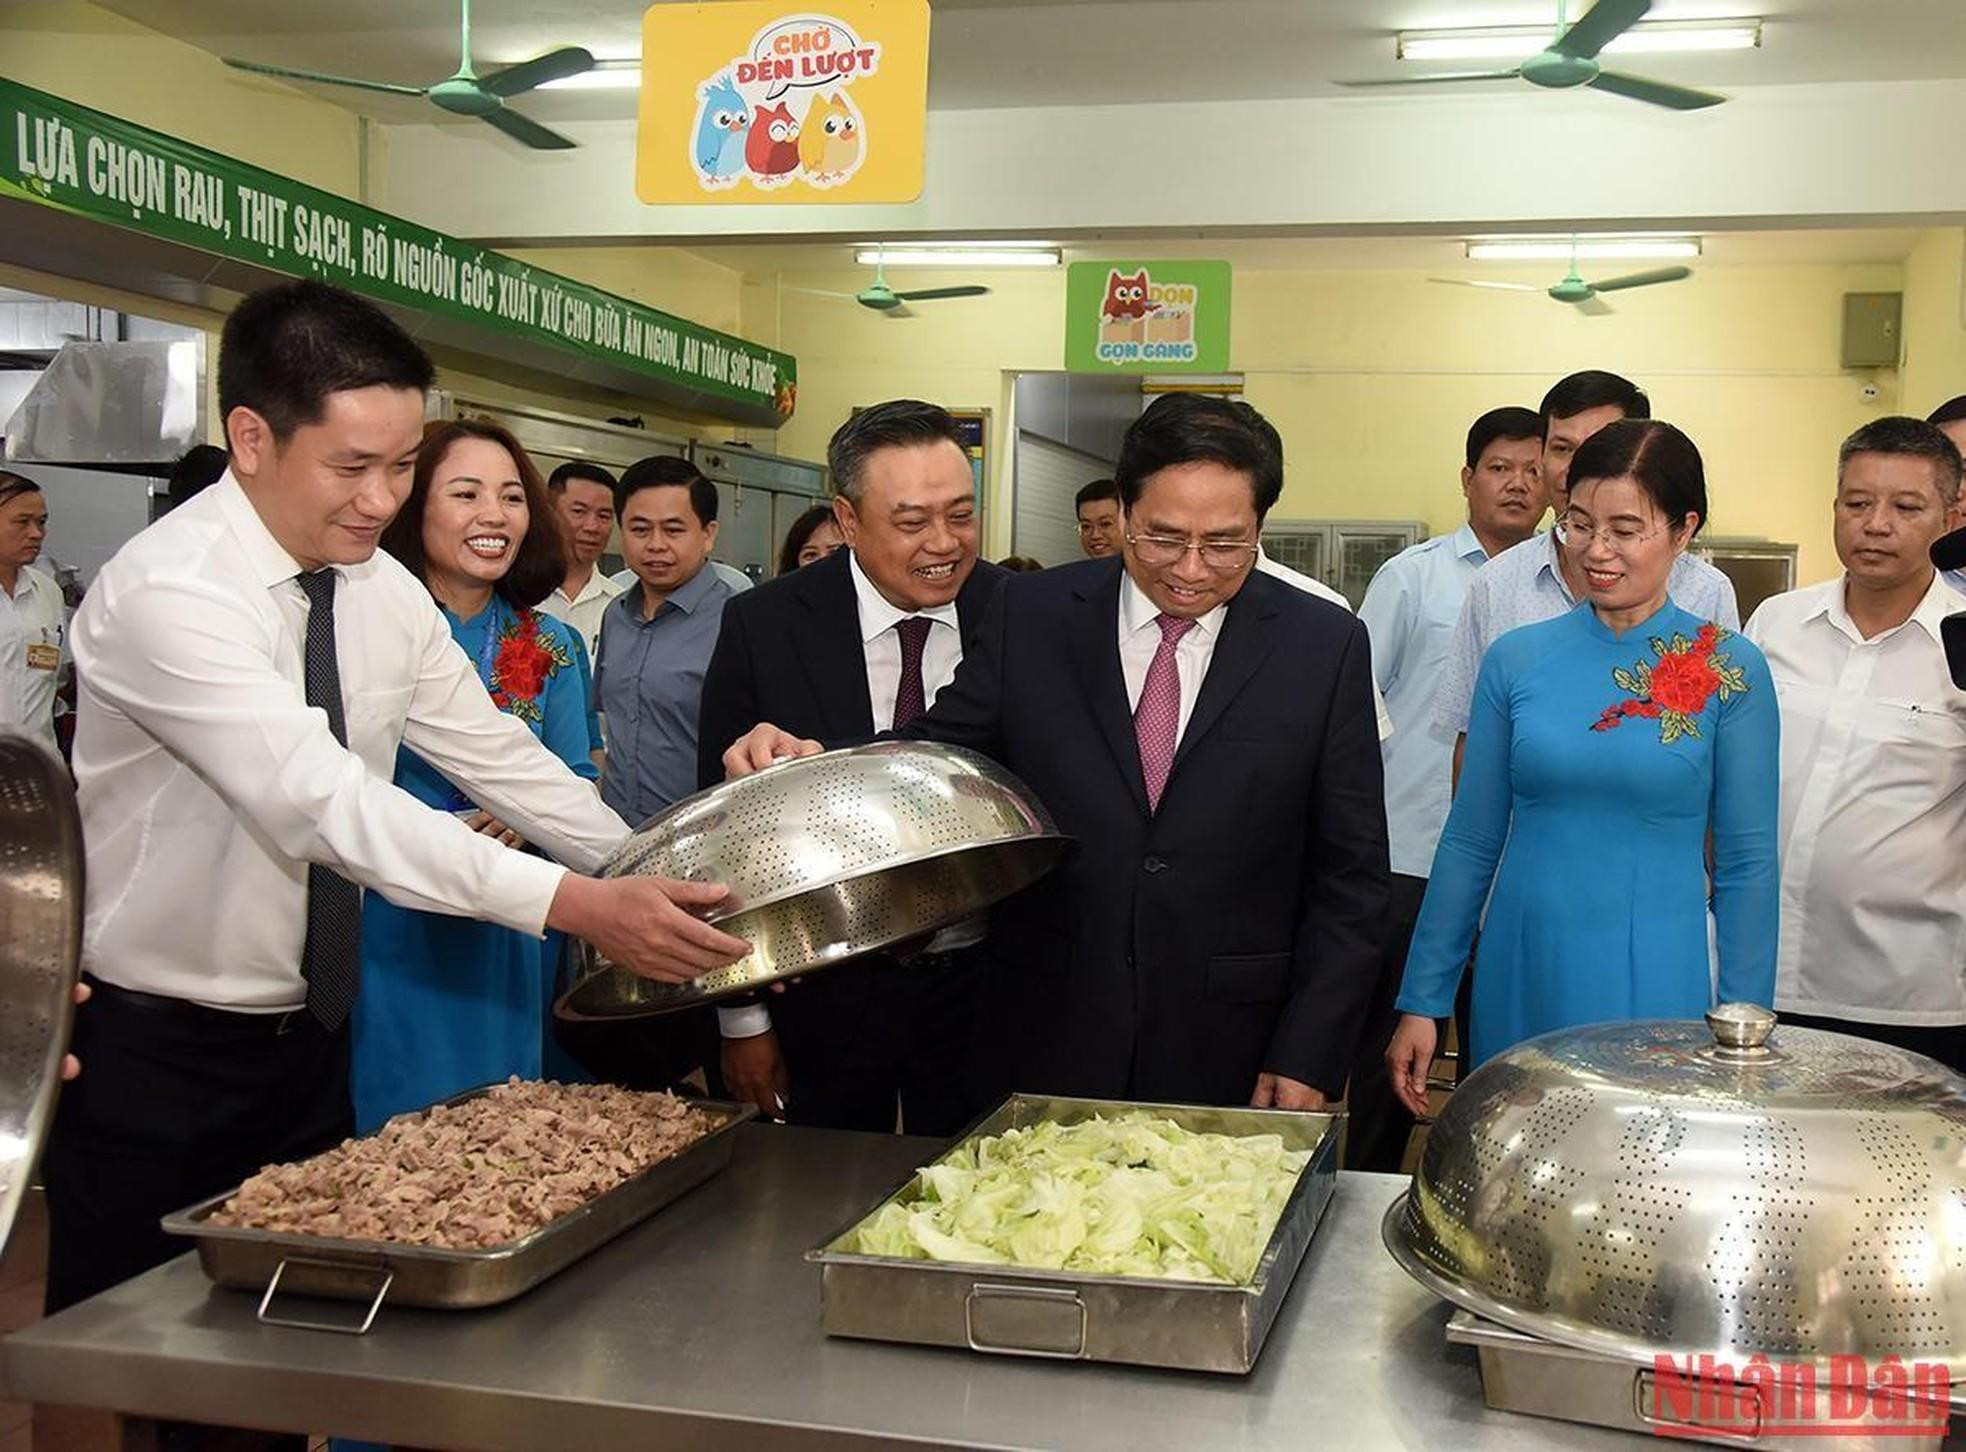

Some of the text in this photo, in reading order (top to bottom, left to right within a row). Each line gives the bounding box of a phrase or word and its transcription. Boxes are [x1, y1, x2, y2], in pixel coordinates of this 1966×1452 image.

[773, 26, 831, 55] CHỜ
[736, 48, 875, 84] ĐẾN LƯỢT
[17, 111, 79, 194] LỰA
[87, 135, 166, 219] CHỌN
[174, 164, 231, 240] RAU,
[237, 185, 288, 258] THỊT
[294, 204, 356, 277] SẠCH,
[362, 224, 388, 280] RÕ
[394, 237, 456, 300] NGUỒN
[460, 252, 494, 312] GỐC
[498, 268, 538, 325] XUẤT
[540, 284, 562, 332] XỨ
[564, 296, 591, 341] CHO
[594, 303, 621, 351] BỮA
[644, 323, 680, 373] NGON,
[682, 336, 700, 375] AN
[701, 340, 730, 383] TOÀN
[730, 347, 750, 389] SỨC
